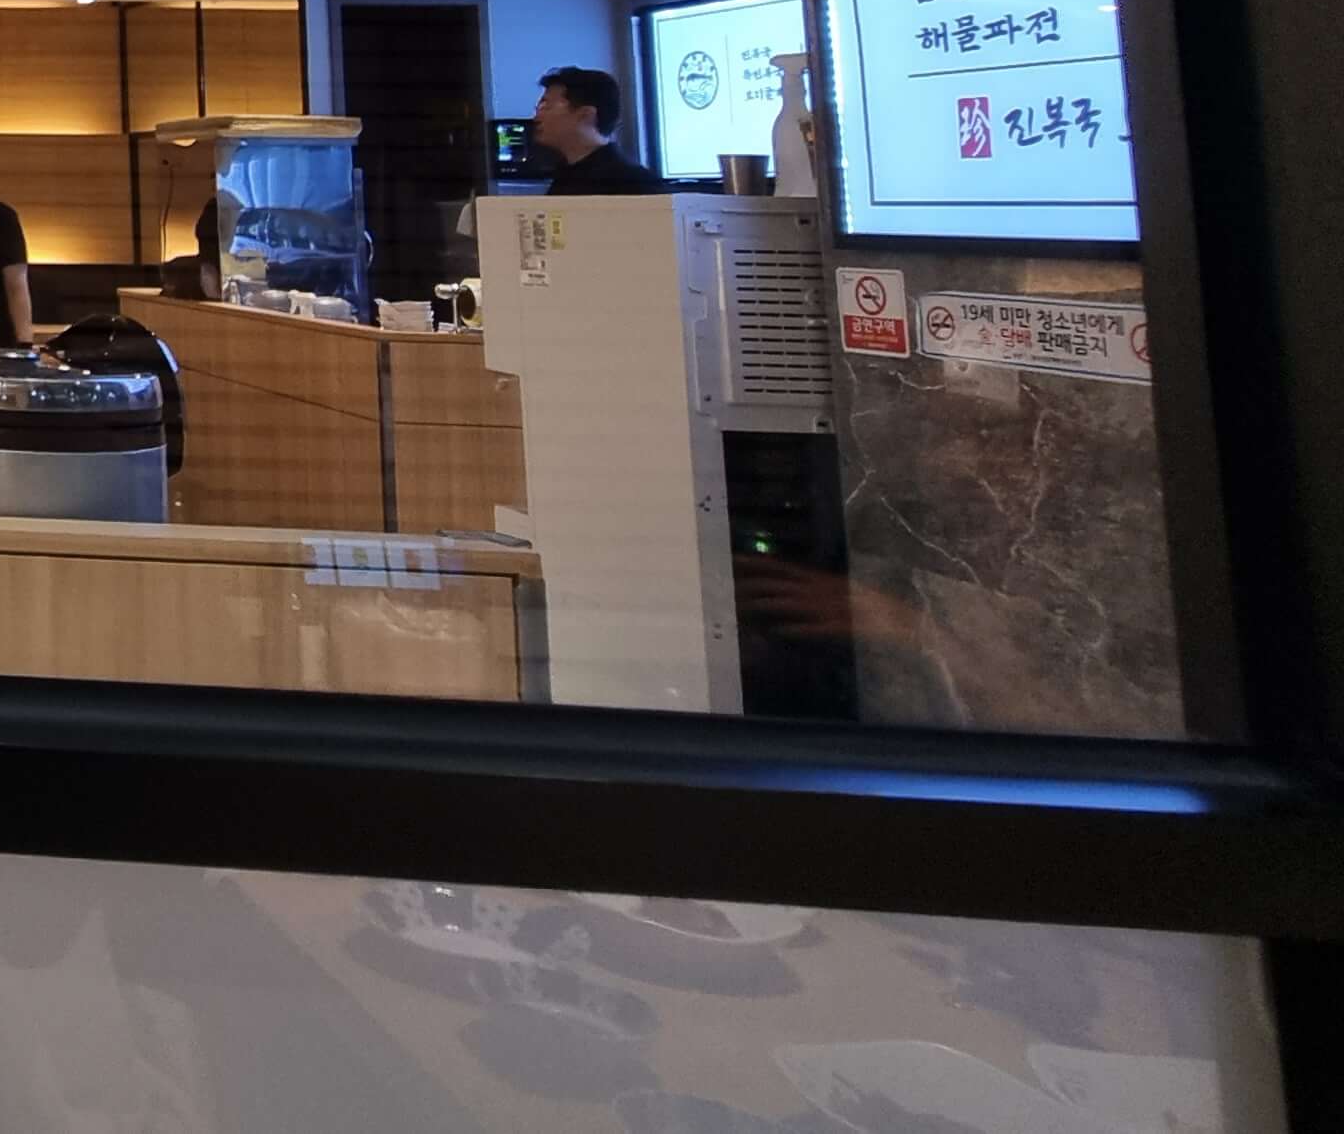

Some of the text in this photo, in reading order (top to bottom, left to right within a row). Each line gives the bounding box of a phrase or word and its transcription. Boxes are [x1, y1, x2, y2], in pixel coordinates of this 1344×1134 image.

[916, 6, 1061, 53] 해물파전
[1004, 96, 1102, 149] 진복국
[960, 304, 1126, 336] 19세 미만 청소년에게
[1037, 331, 1108, 357] 판매금지
